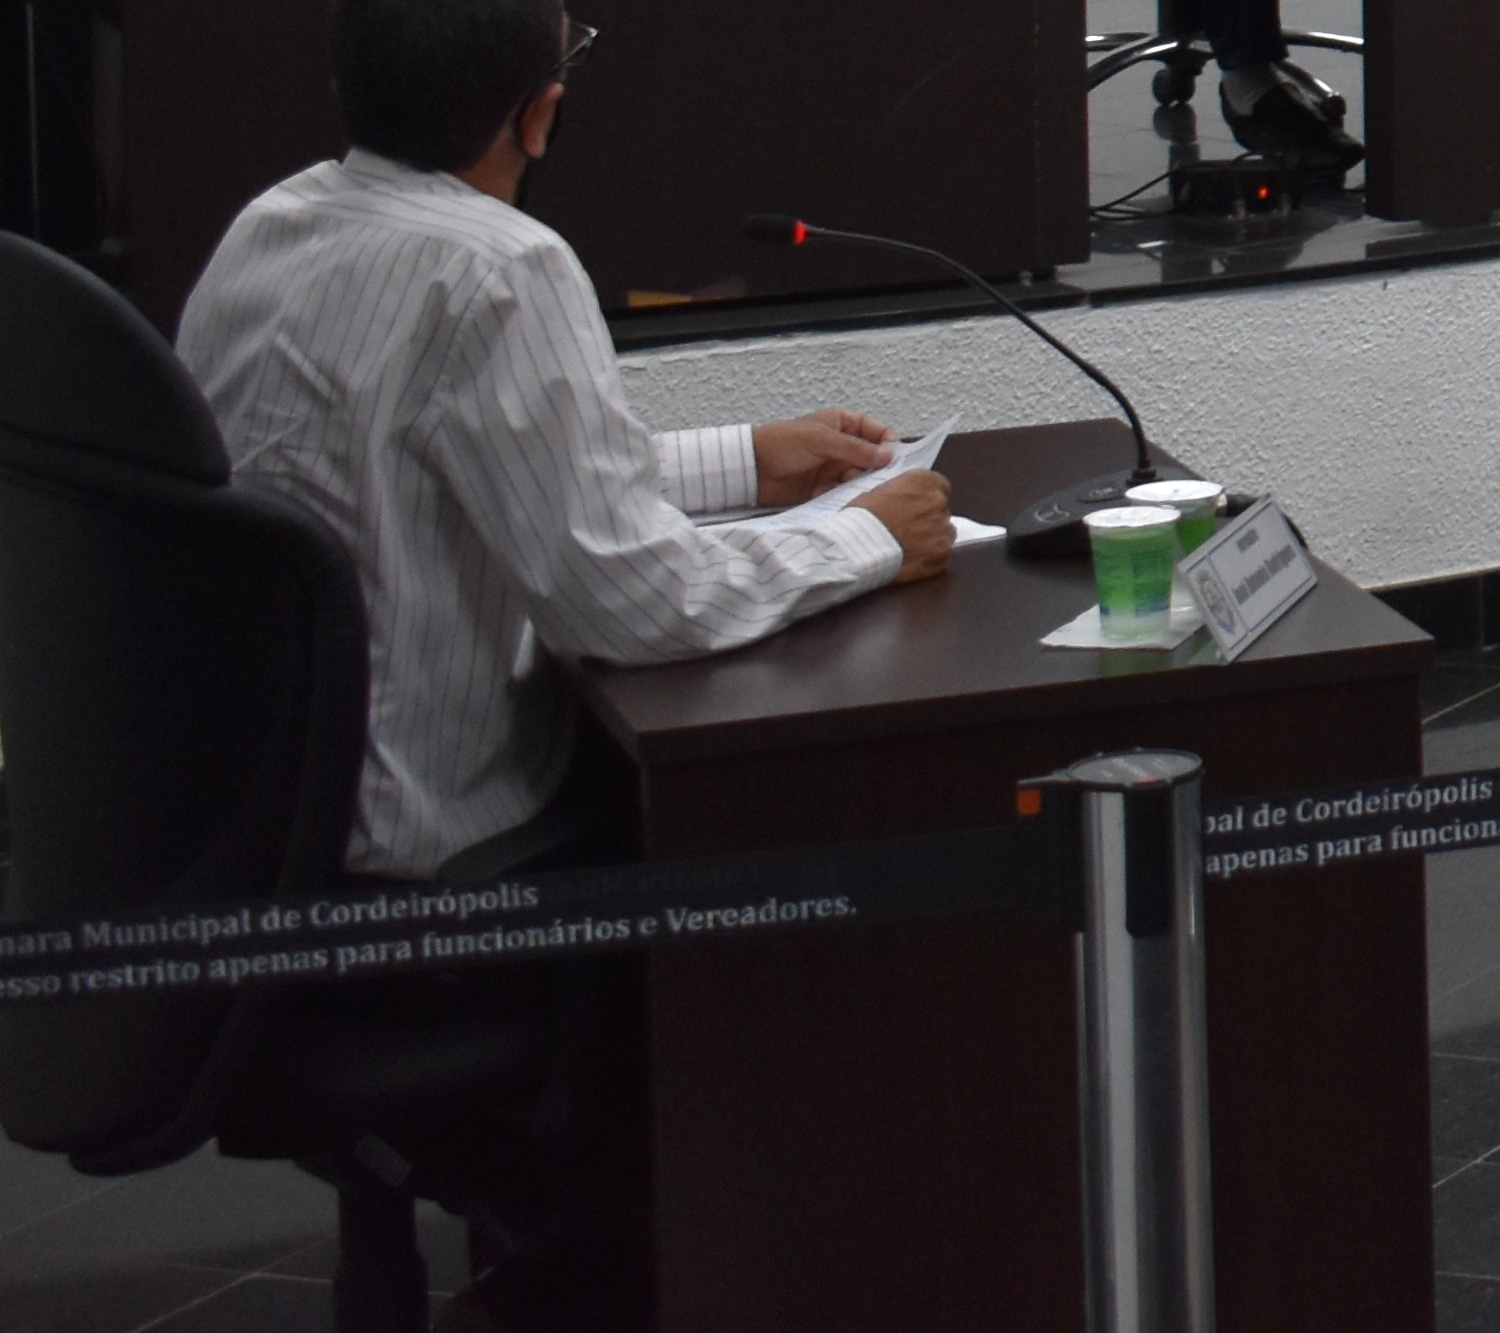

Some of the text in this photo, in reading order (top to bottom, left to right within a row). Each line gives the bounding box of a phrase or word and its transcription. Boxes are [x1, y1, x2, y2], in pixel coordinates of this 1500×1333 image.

[1253, 800, 1288, 829] de
[1296, 776, 1494, 824] Cordeirópolis
[1206, 841, 1309, 879] apenas
[1316, 833, 1382, 865] para
[70, 957, 200, 993] restrito
[207, 948, 330, 987] apenas
[337, 941, 414, 973] para
[421, 915, 632, 959] funcionários
[637, 916, 659, 937] e
[664, 893, 858, 935] Vereadores.
[82, 907, 253, 949] Municipal
[259, 905, 301, 928] de
[309, 883, 540, 926] Cordeirópolis
